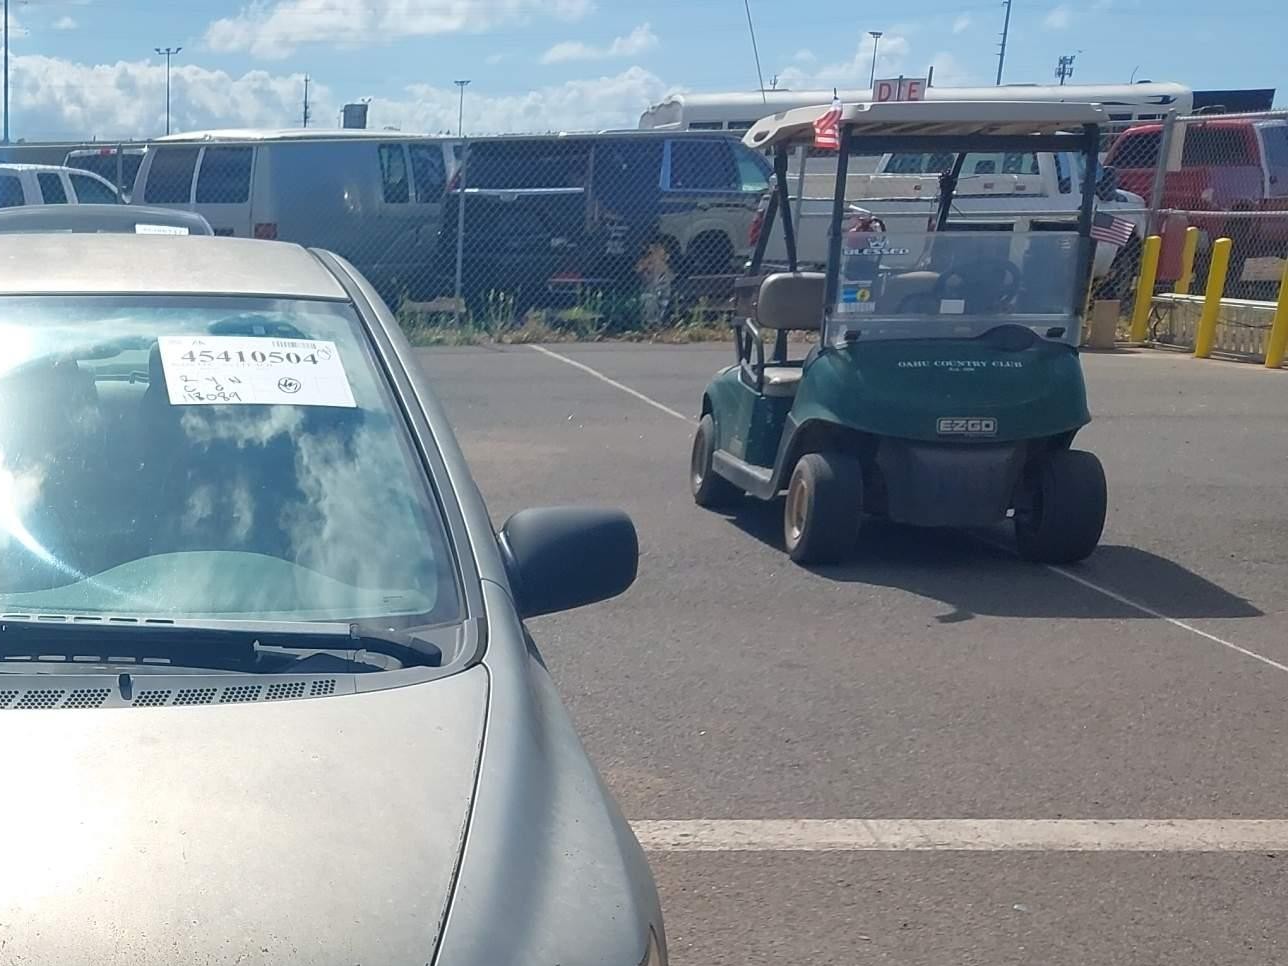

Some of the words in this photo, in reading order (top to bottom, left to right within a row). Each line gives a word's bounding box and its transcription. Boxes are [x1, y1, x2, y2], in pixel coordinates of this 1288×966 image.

[180, 349, 319, 365] 45410504
[898, 360, 930, 368] OAHU
[933, 360, 987, 368] COUNTRY
[991, 360, 1024, 368] CLUB
